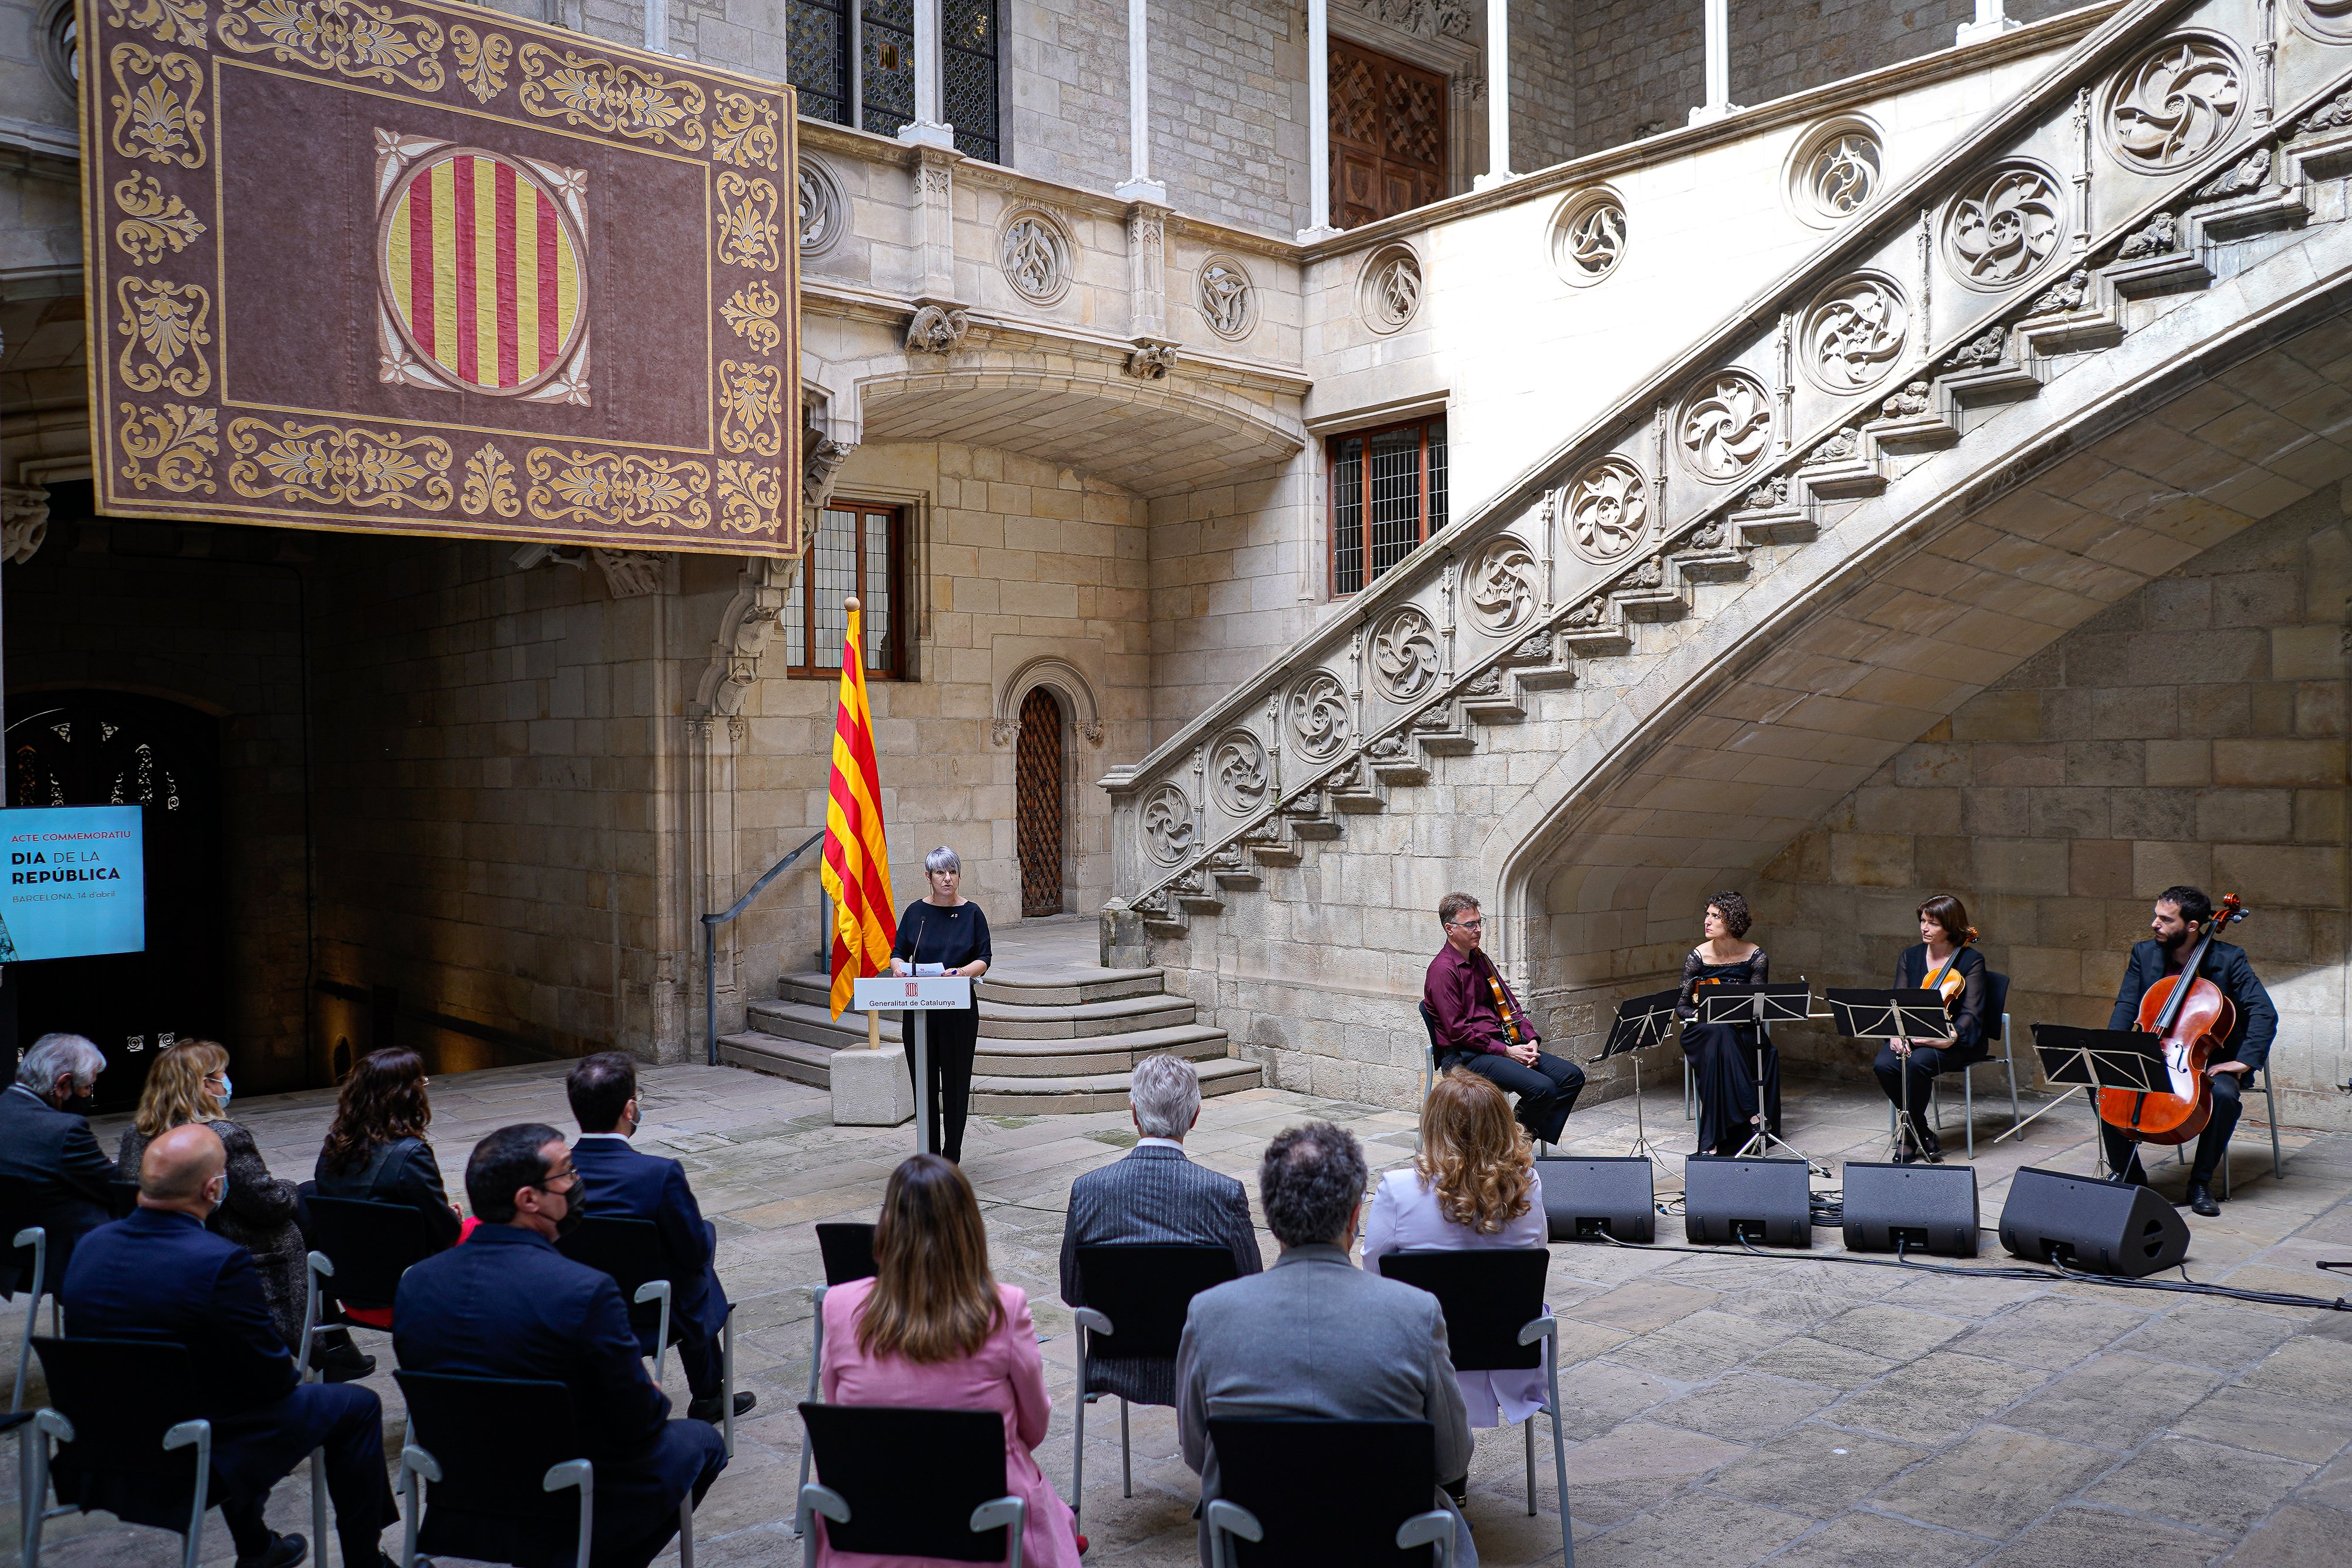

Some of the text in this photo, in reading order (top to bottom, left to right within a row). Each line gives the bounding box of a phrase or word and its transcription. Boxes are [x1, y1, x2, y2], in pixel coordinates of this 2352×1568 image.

[11, 831, 131, 842] ACTE COMMEMORATIU
[12, 851, 100, 865] DIA DE LA
[12, 867, 121, 885] REPÚBLICA
[12, 893, 75, 903] BARCELONA,
